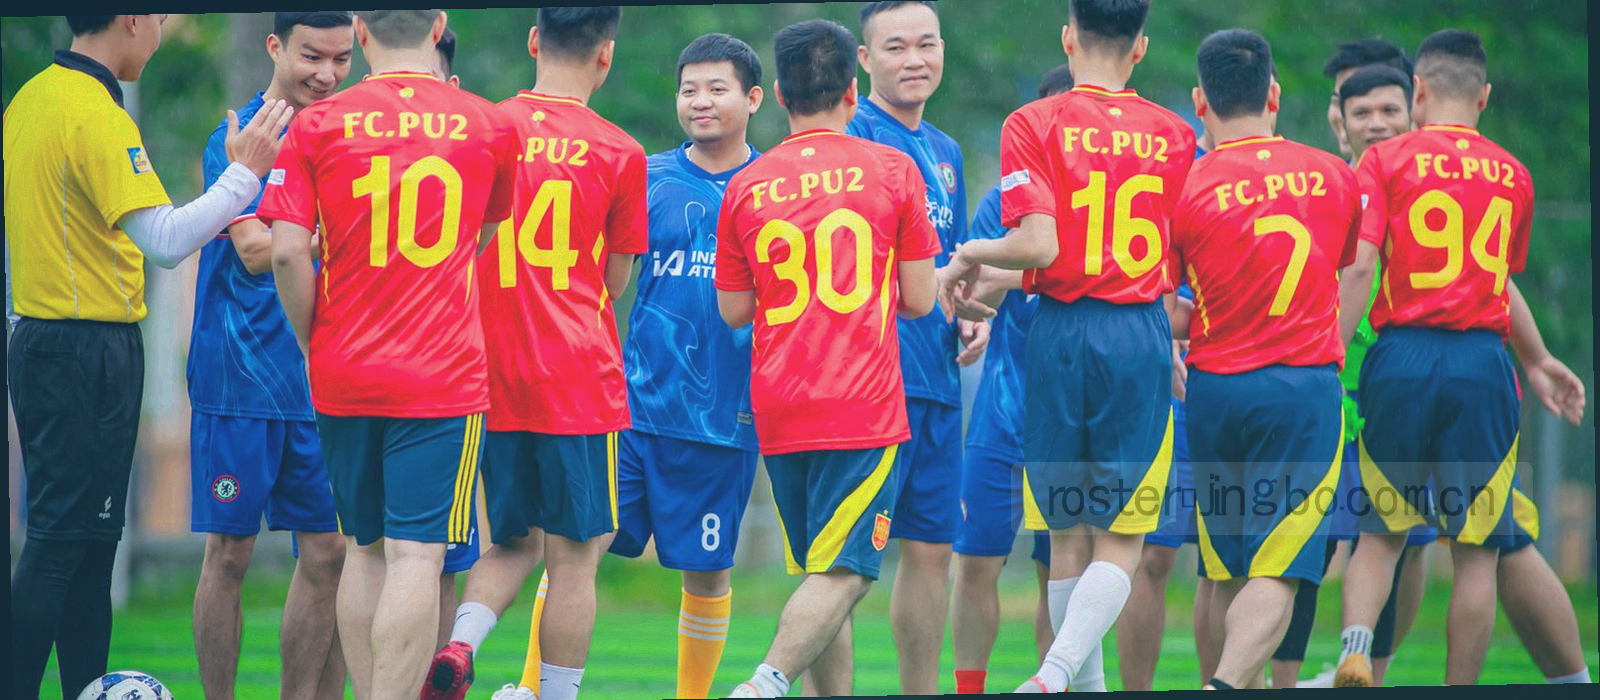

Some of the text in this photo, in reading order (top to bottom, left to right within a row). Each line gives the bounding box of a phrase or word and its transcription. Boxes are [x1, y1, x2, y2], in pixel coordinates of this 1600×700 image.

[344, 111, 468, 140] FC.PU2
[1063, 127, 1168, 163] FC.PU2
[517, 137, 589, 166] .PU2
[1416, 154, 1515, 188] FC.PU2
[752, 167, 864, 209] FC.PU2
[1215, 172, 1327, 210] FC.PU2
[352, 155, 462, 268] 10
[1071, 171, 1163, 279] 16
[1408, 190, 1513, 296] 94
[755, 208, 873, 326] 30
[1254, 214, 1311, 316] 7
[701, 512, 720, 551] 8
